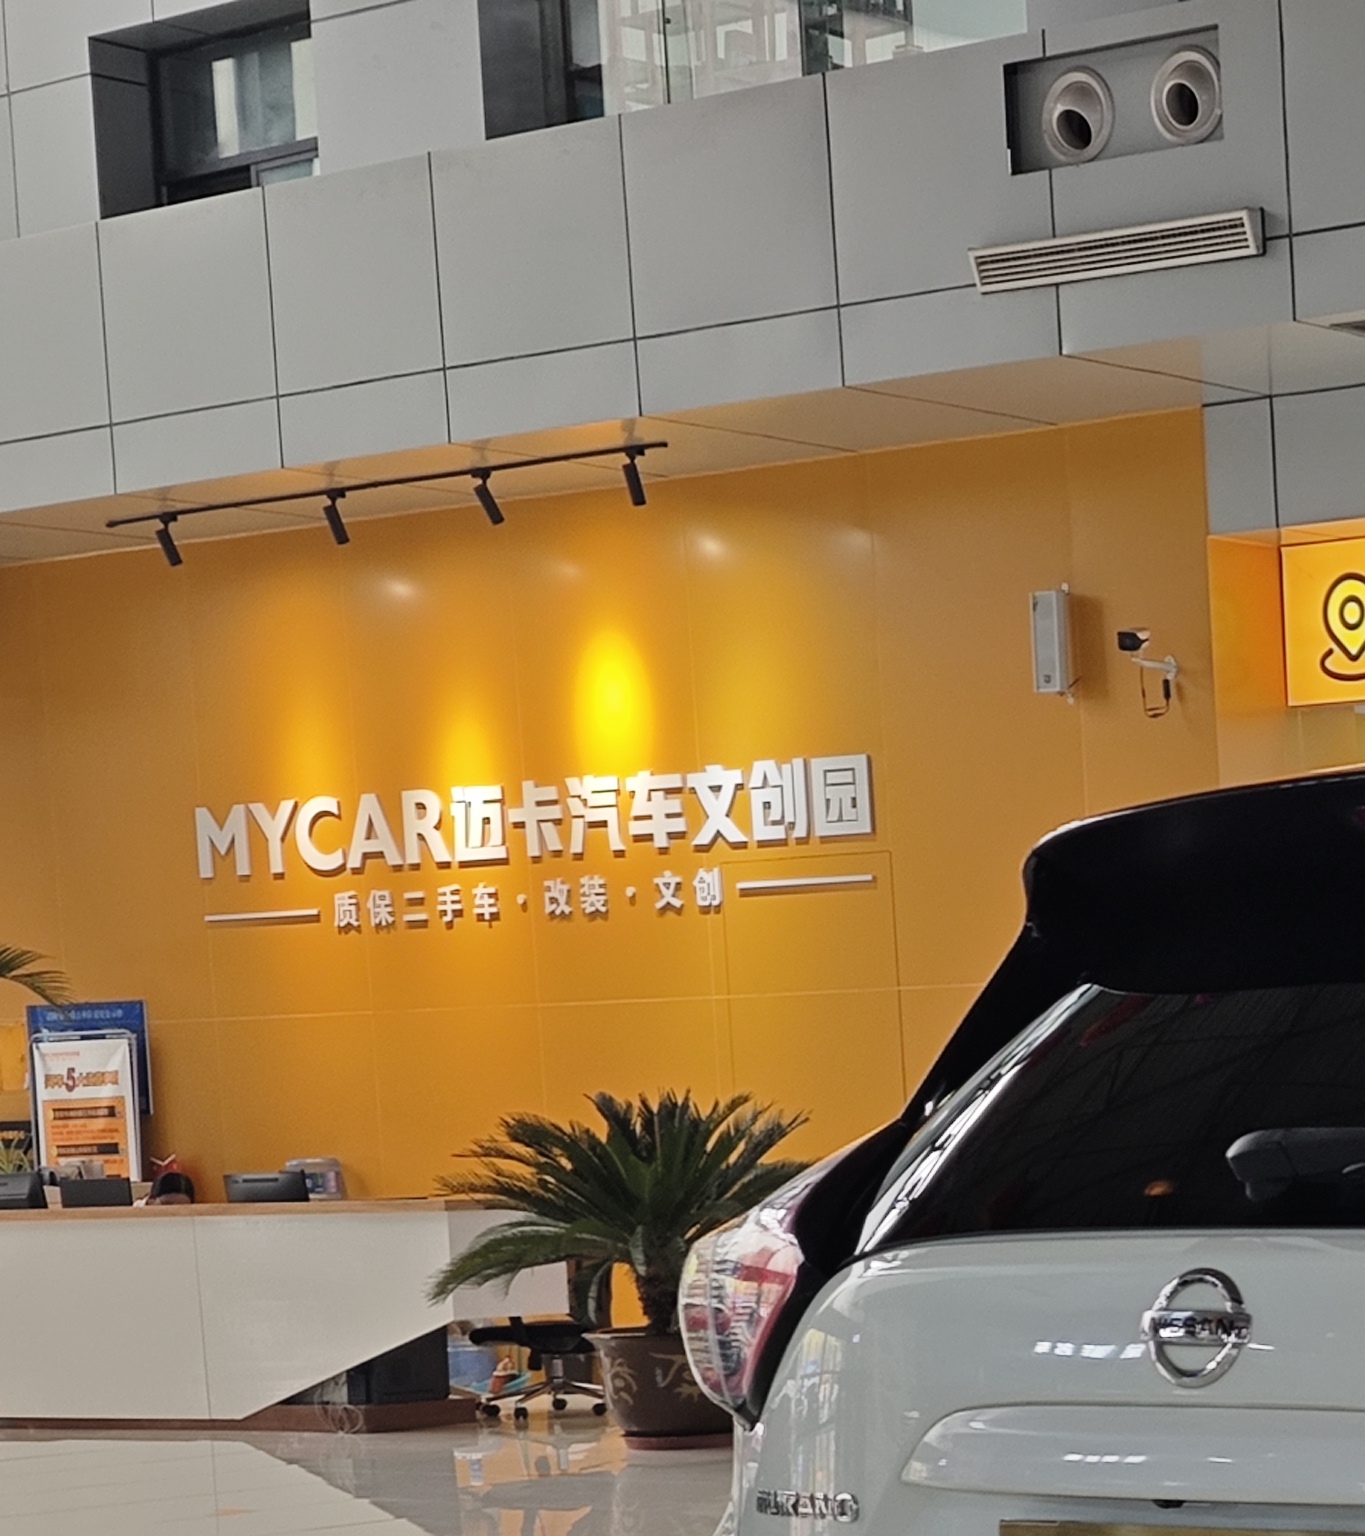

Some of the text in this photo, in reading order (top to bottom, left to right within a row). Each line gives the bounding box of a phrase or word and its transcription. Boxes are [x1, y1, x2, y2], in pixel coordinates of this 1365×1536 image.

[194, 752, 874, 880] MYCAR迈卡汽车文创园
